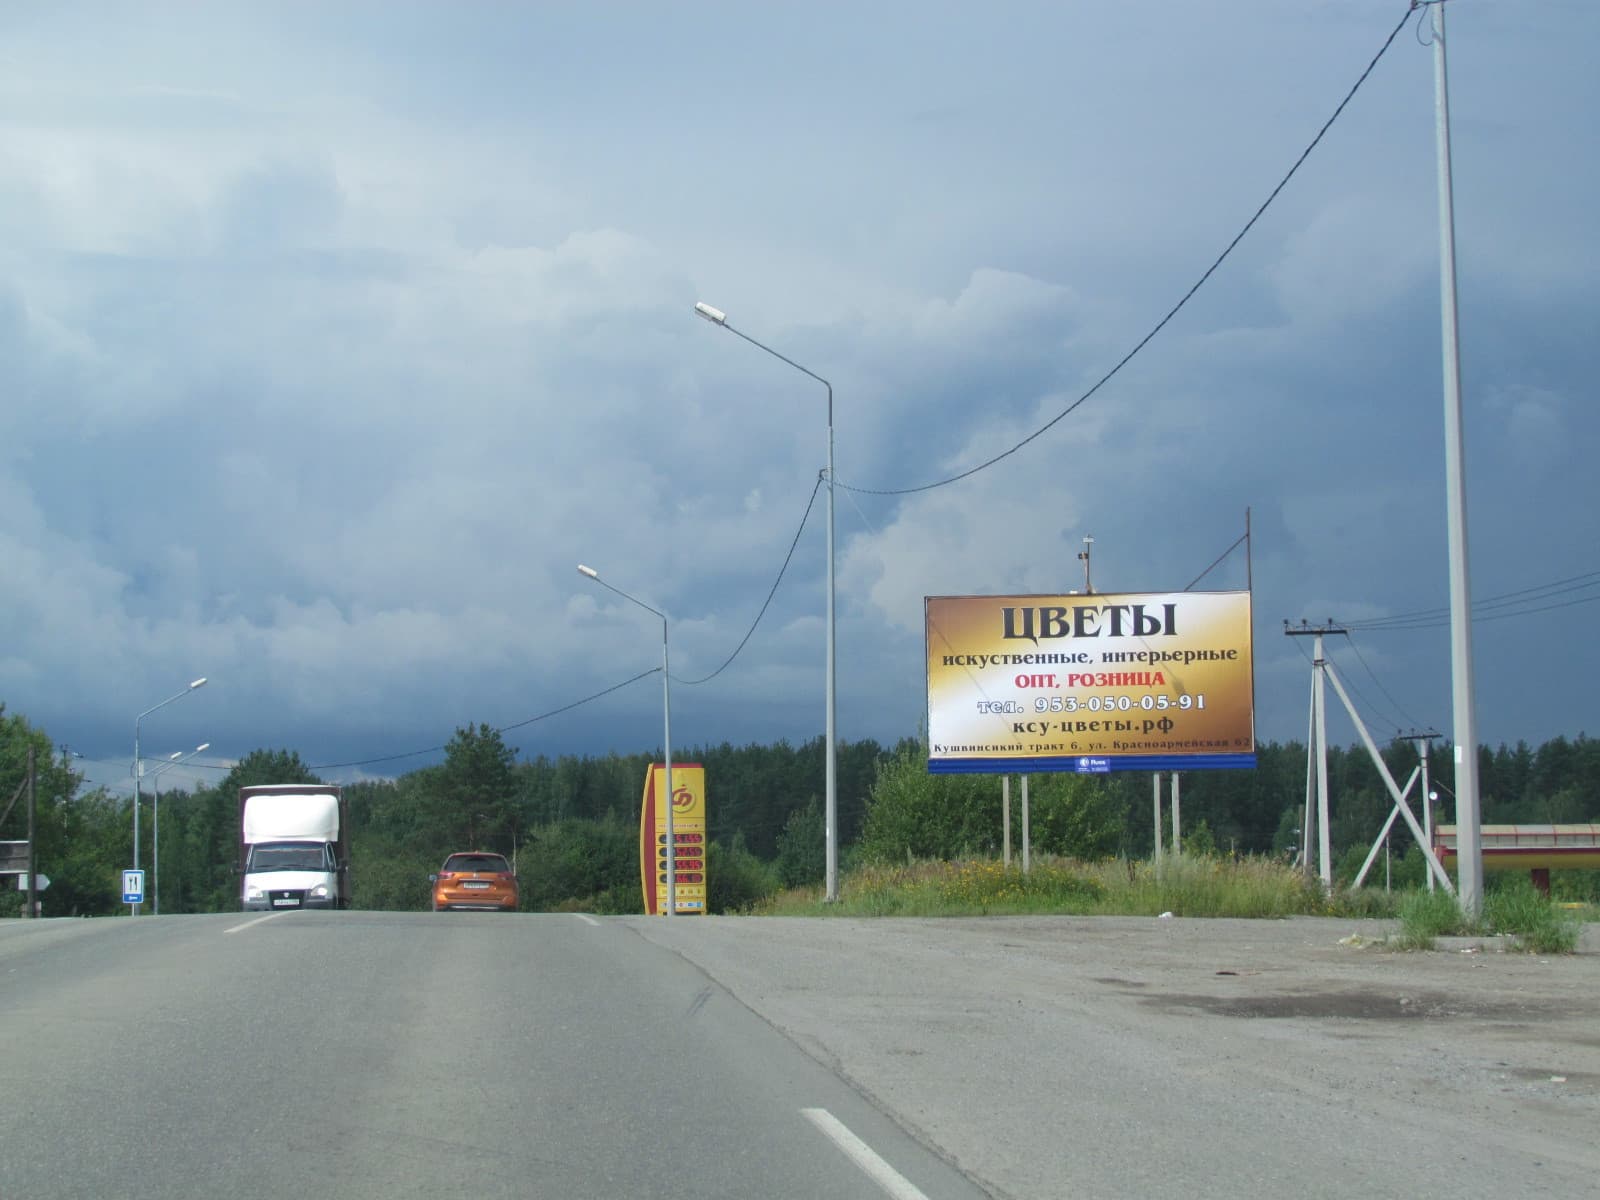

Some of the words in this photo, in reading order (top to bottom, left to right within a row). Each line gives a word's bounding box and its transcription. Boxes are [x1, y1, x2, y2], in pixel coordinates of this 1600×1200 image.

[1002, 603, 1177, 648] ЦВЕТЫ
[943, 651, 1093, 669] искуственные,
[1102, 649, 1238, 666] интерьерные
[1015, 674, 1060, 689] ОПТ,
[1068, 671, 1166, 688] РОЗНИЦА
[977, 700, 1025, 714] тел.
[1034, 693, 1206, 713] 953-050-05-91
[1013, 716, 1175, 736] ксу-цветы.рф
[1029, 743, 1065, 753] тракт
[1088, 742, 1107, 750] ул.
